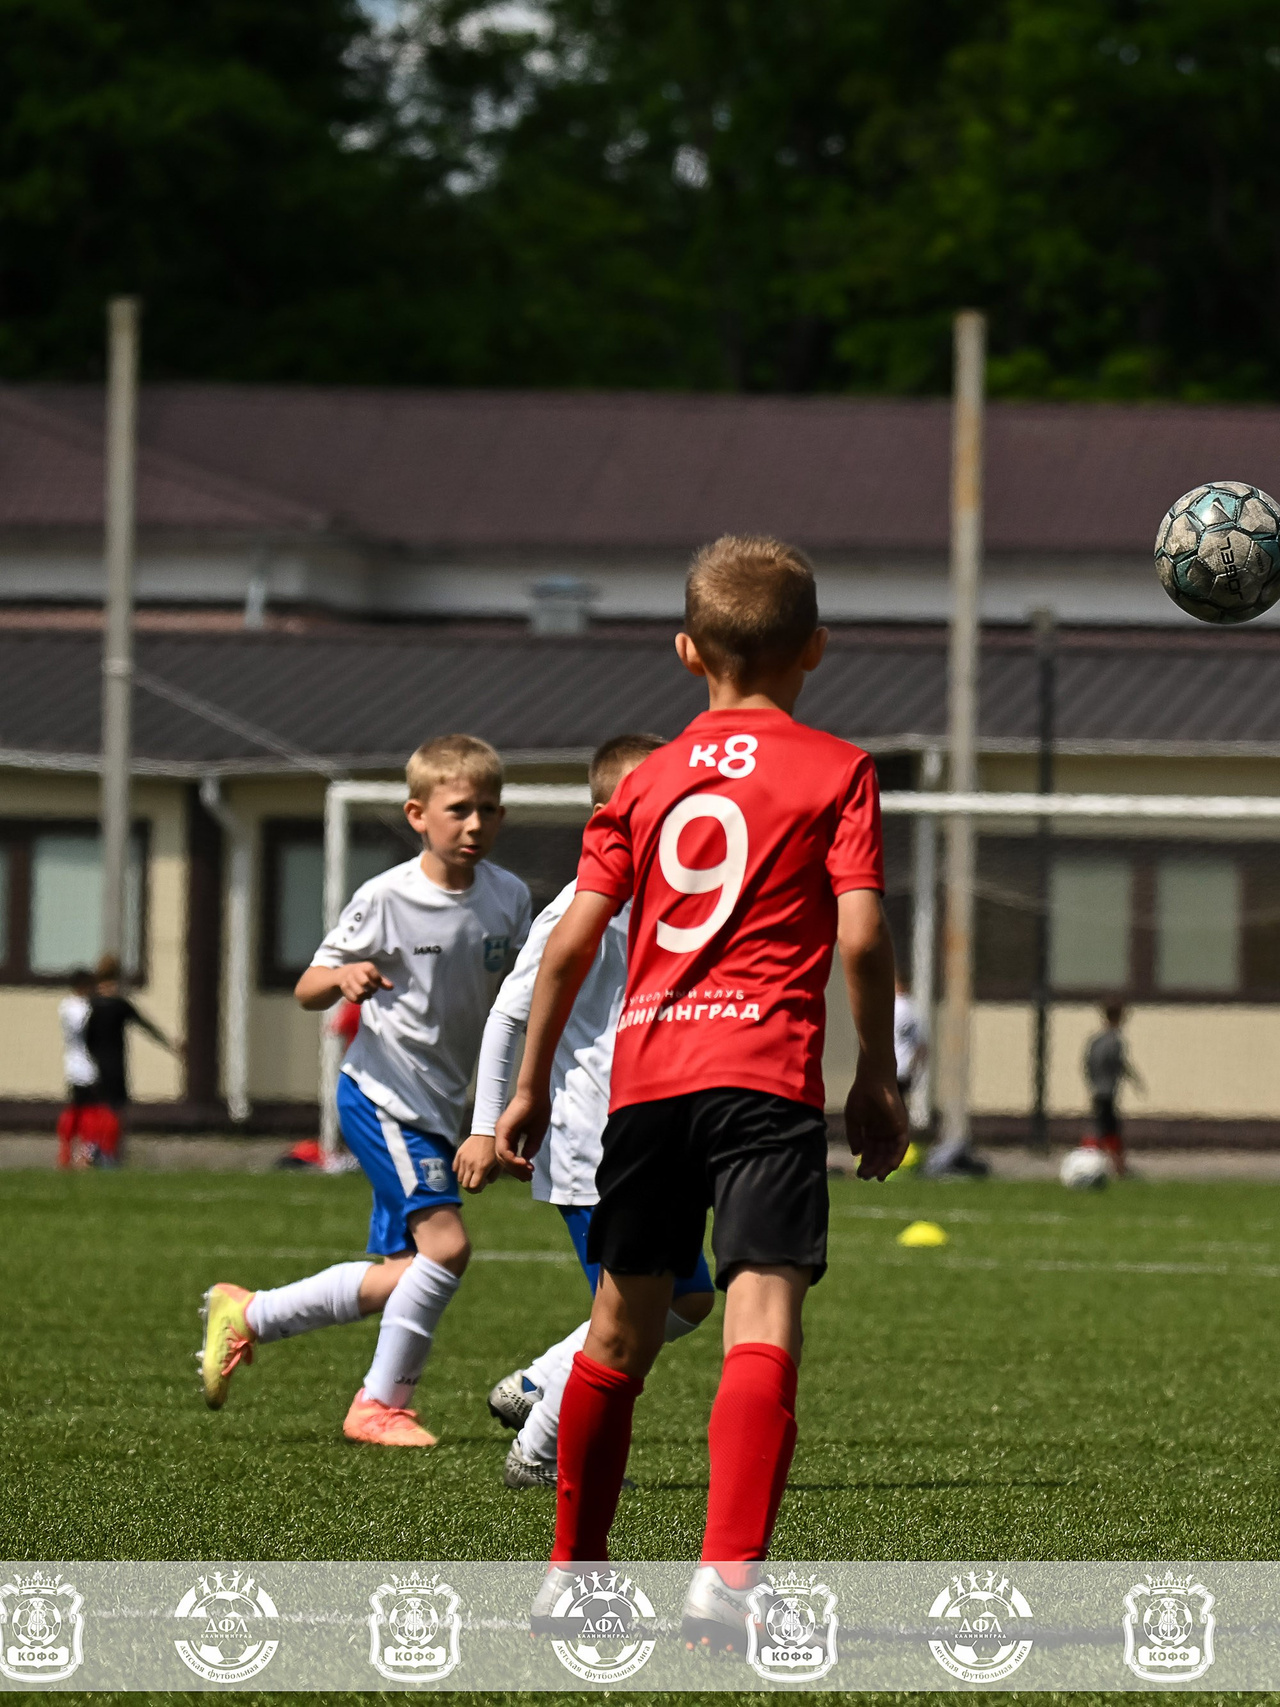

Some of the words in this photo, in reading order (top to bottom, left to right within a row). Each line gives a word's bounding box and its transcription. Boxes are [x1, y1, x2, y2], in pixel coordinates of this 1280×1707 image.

[656, 793, 749, 954] 9
[703, 990, 745, 1000] КЛУБ
[617, 1003, 760, 1032] АЛИНИНГРАД
